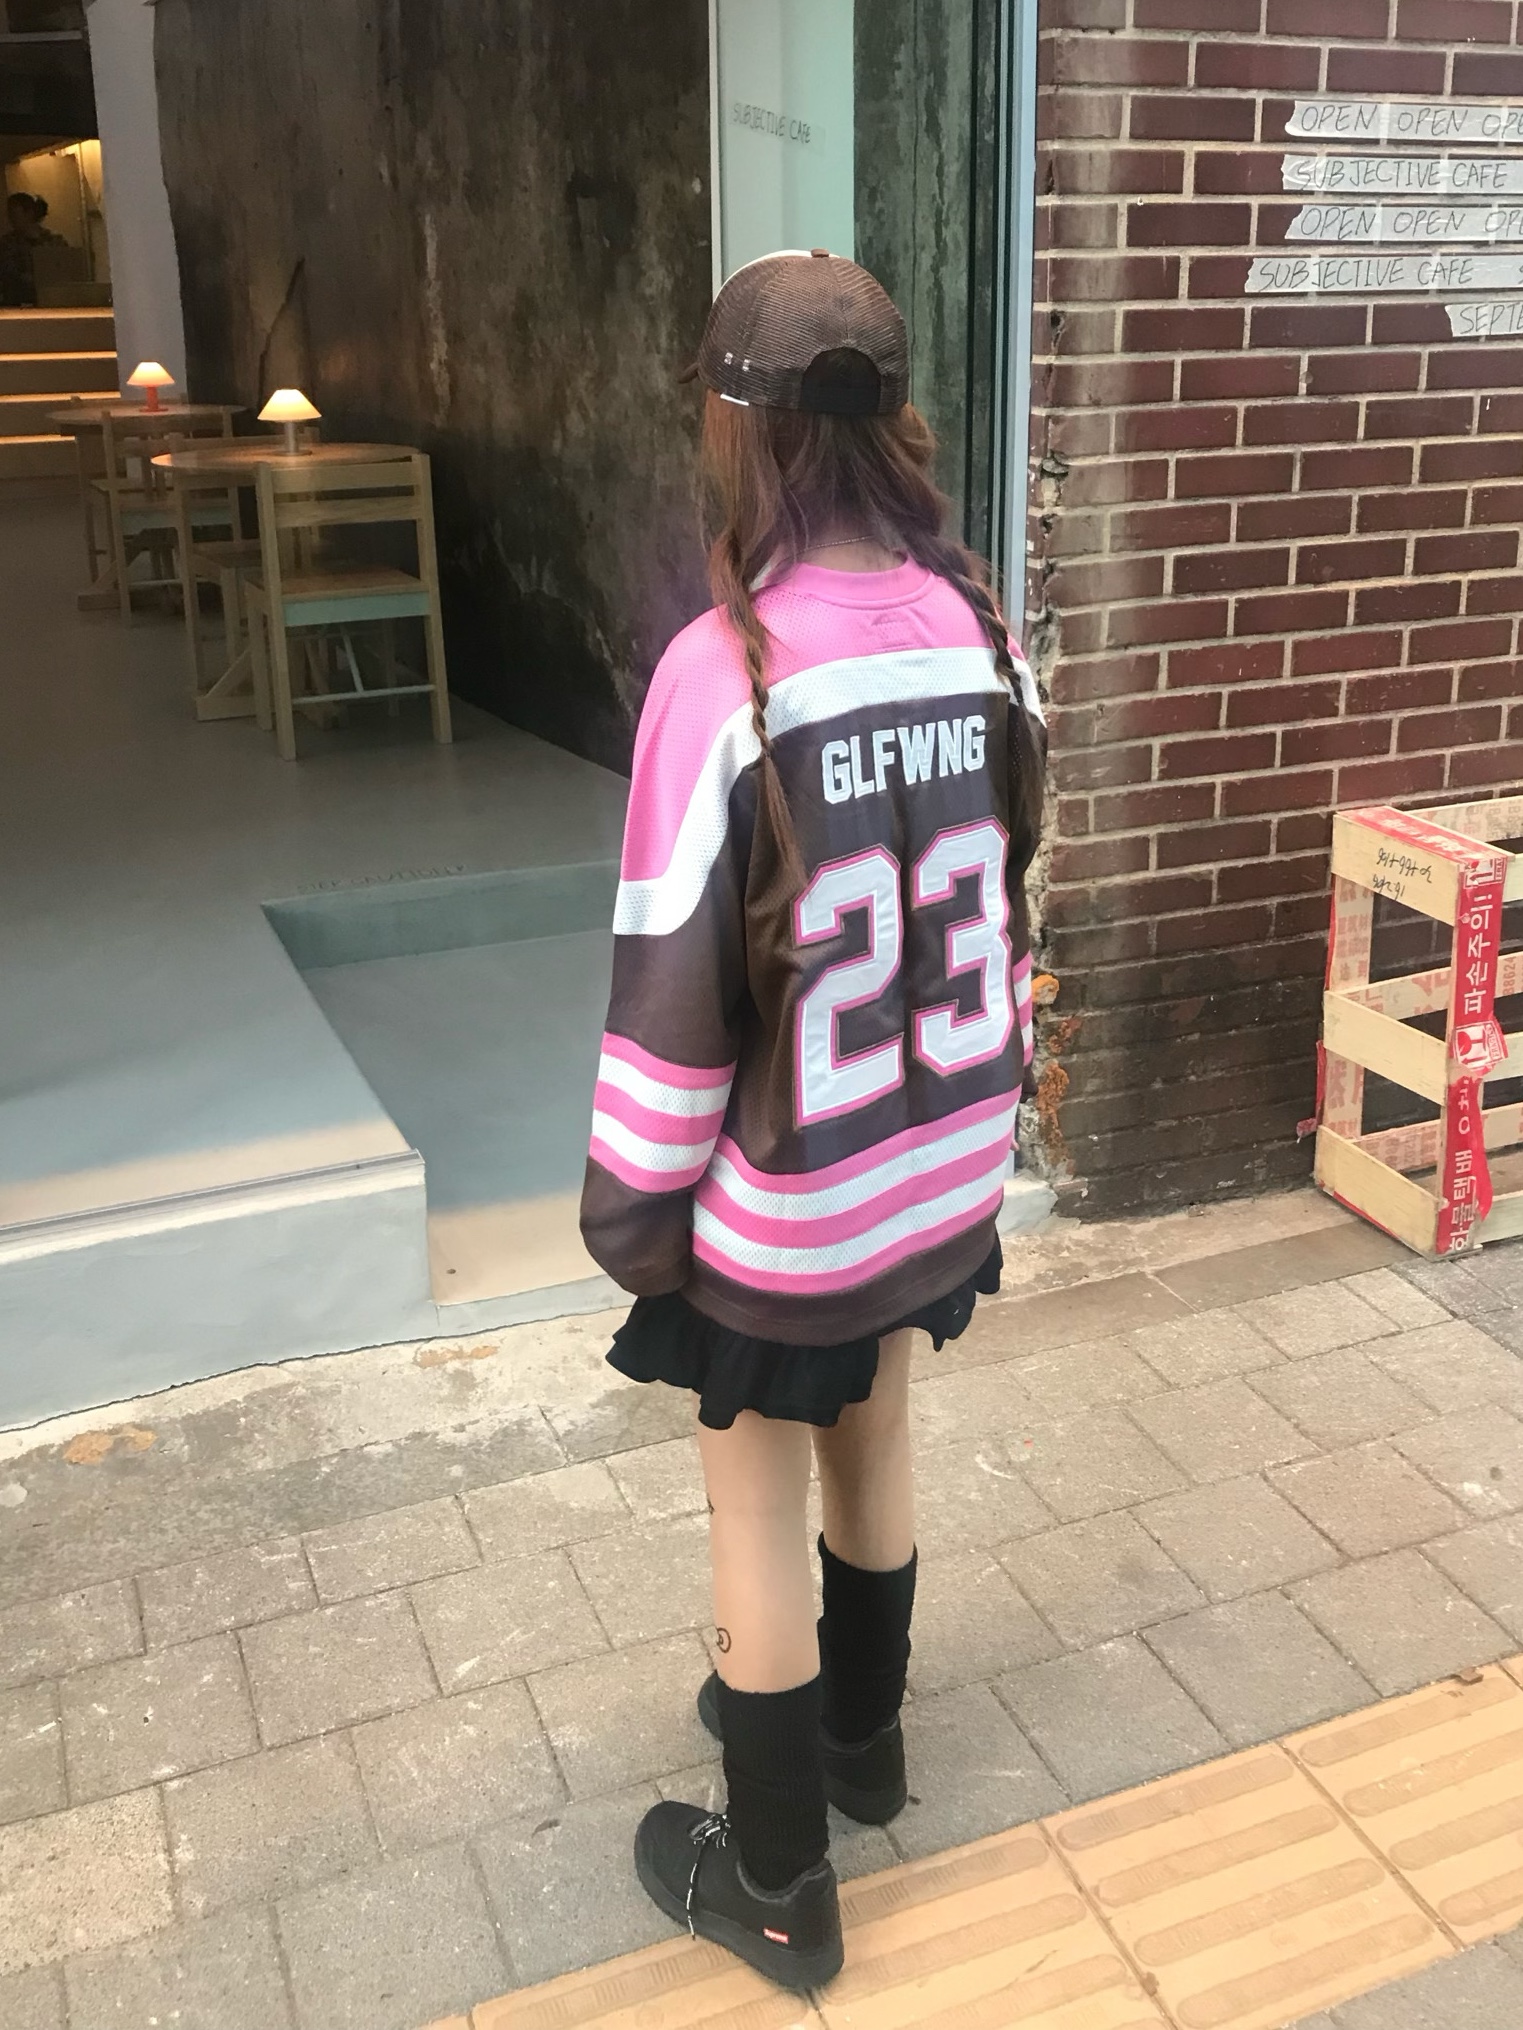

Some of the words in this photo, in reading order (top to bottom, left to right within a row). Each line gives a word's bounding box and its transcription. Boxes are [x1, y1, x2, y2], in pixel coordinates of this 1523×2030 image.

[1301, 105, 1378, 132] OPEN
[1397, 107, 1468, 136] OPEN
[1296, 160, 1440, 190] SUBJECTIVE
[1452, 162, 1508, 188] CAFE
[1301, 207, 1377, 239] OPEN
[1393, 210, 1466, 236] OPEN
[1259, 257, 1404, 291] SUBJECTIVE
[1417, 258, 1474, 285] CAFE
[821, 714, 986, 805] GLFWNG
[1464, 893, 1494, 1015] 파손주의!
[791, 815, 1015, 1130] 23
